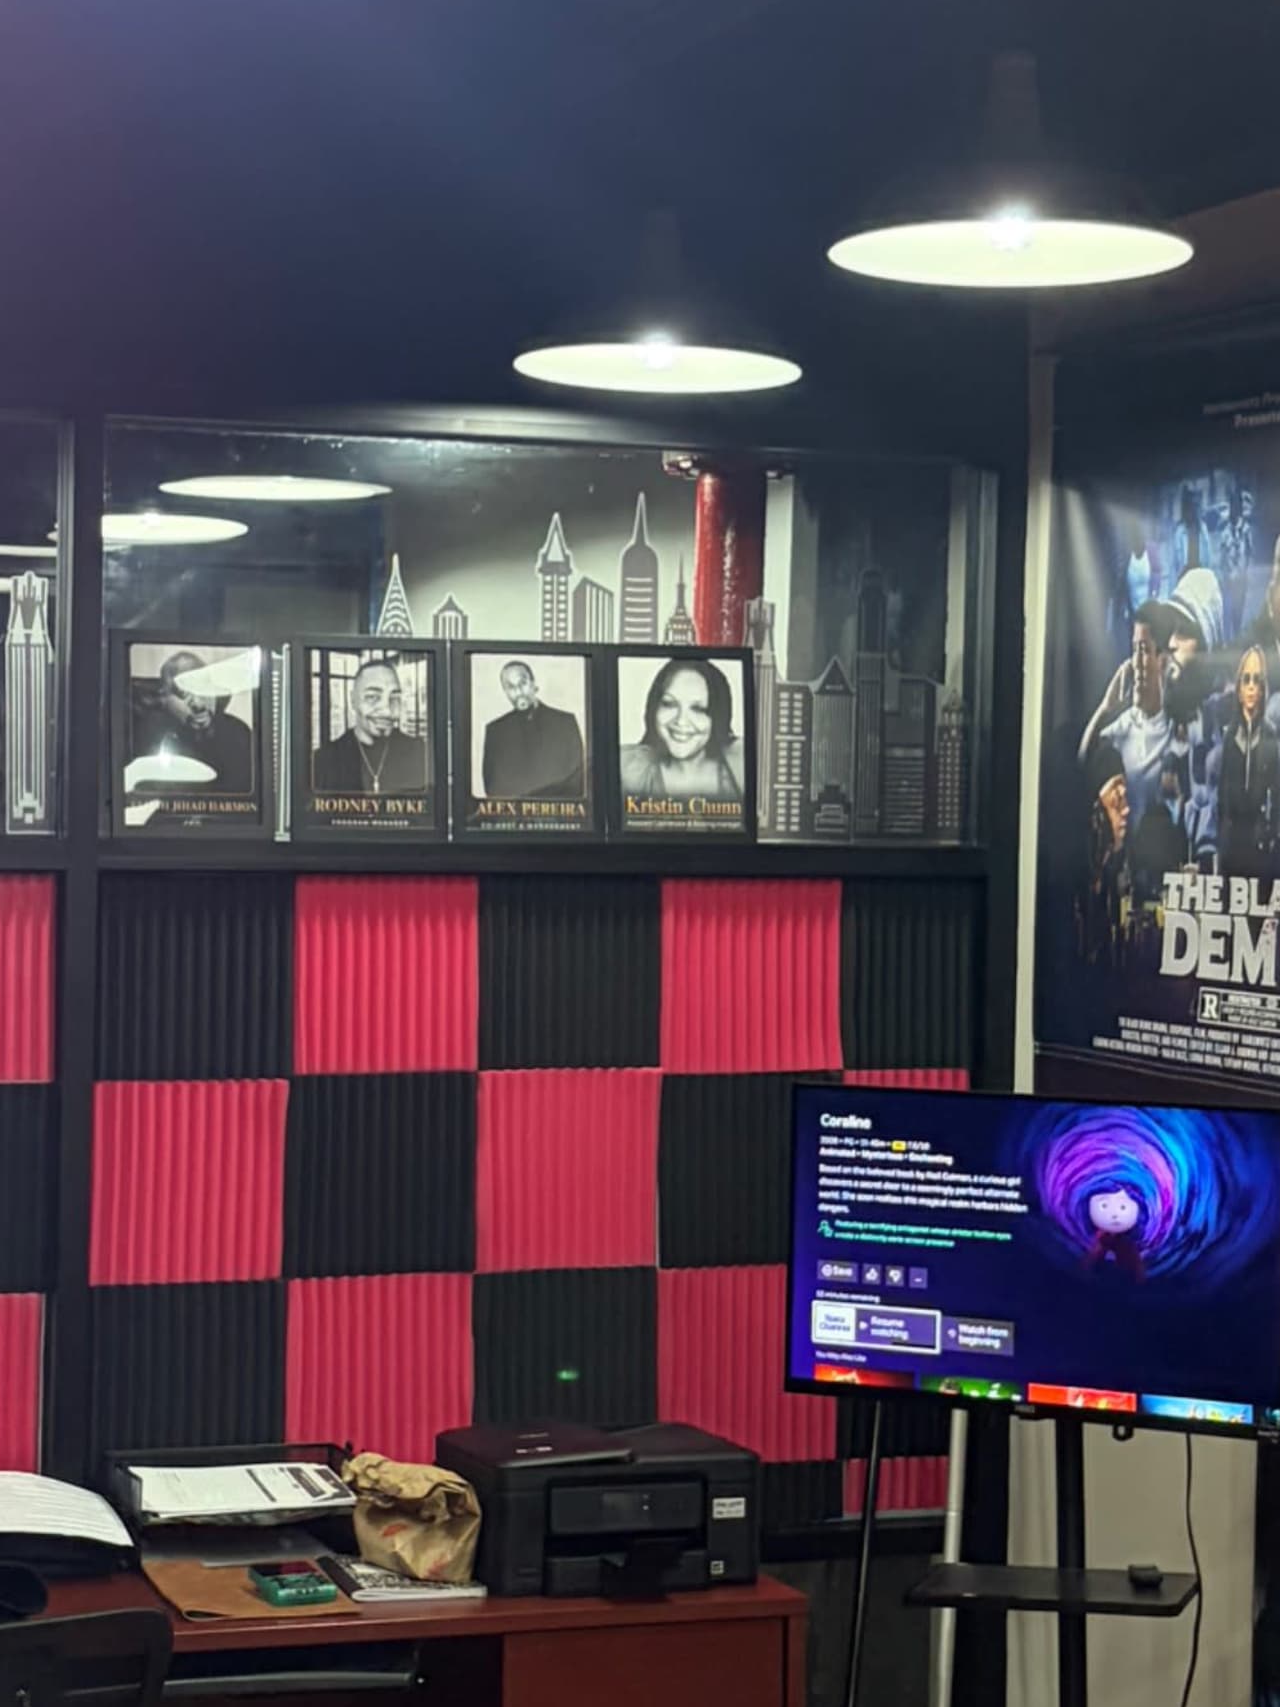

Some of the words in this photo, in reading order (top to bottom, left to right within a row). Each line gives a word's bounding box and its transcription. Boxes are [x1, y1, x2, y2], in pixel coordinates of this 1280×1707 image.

[314, 797, 381, 813] RODNEY
[386, 798, 428, 813] BYKE
[475, 801, 517, 815] ALEX
[521, 802, 587, 816] PEREIRA
[626, 796, 683, 814] Kristin
[688, 797, 742, 815] Chunn
[1163, 871, 1225, 912] THE
[820, 1113, 872, 1130] Coraline
